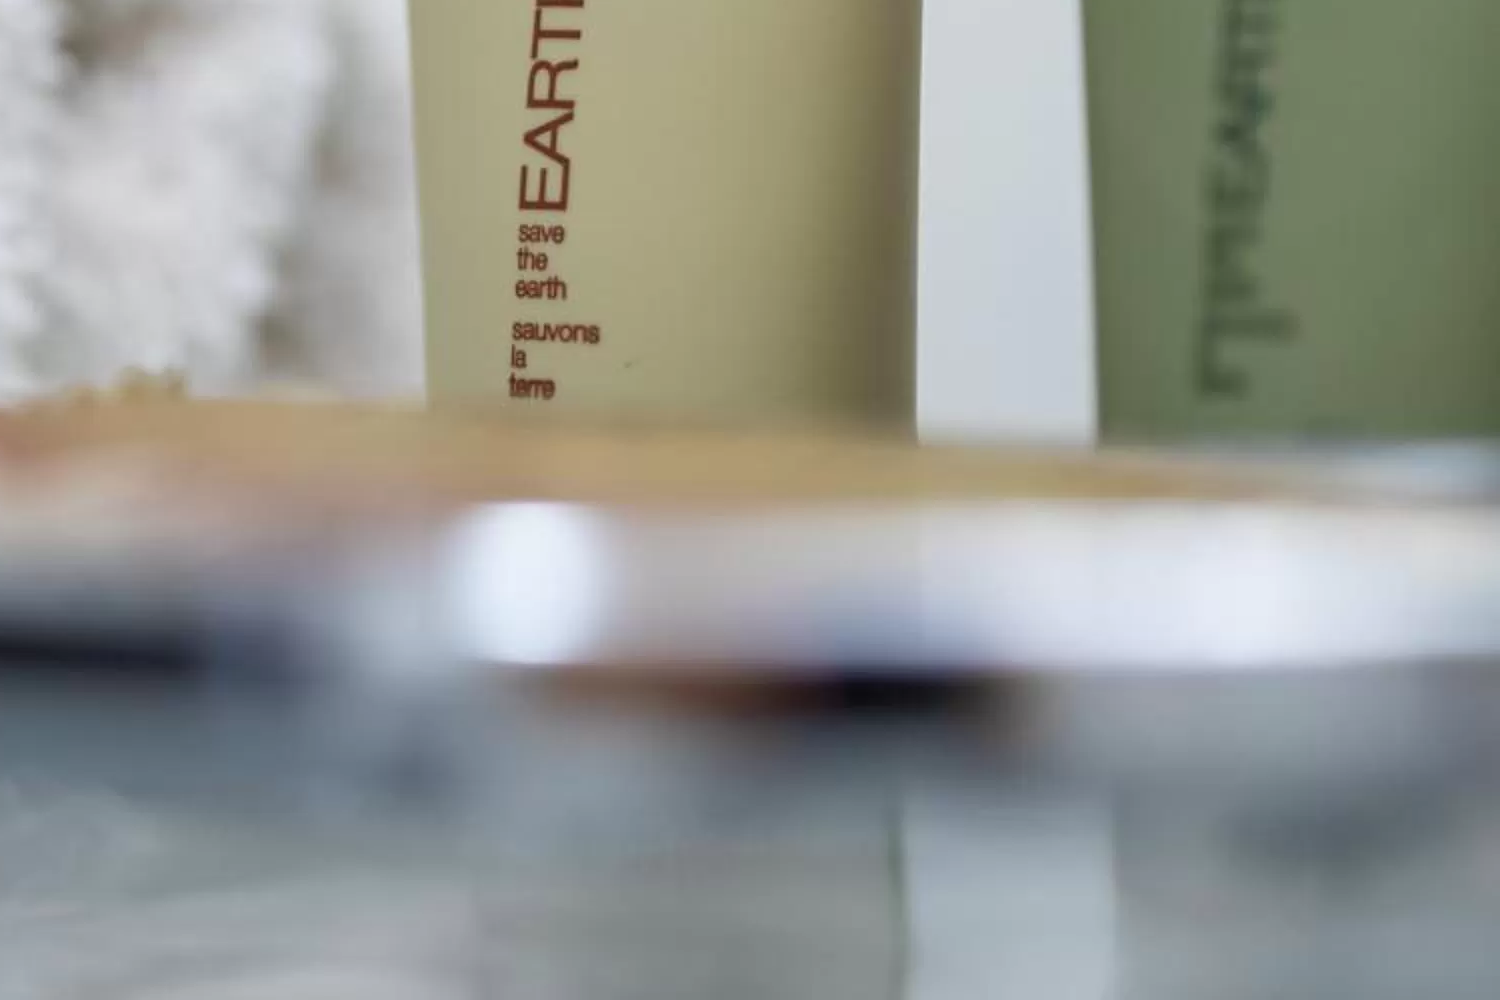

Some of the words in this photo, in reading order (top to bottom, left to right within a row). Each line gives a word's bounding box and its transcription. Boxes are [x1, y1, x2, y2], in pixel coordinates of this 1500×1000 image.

[518, 223, 566, 245] save
[516, 246, 549, 272] the
[514, 275, 568, 301] earth
[511, 321, 601, 345] sauvons
[510, 344, 528, 369] la
[508, 372, 556, 400] terre
